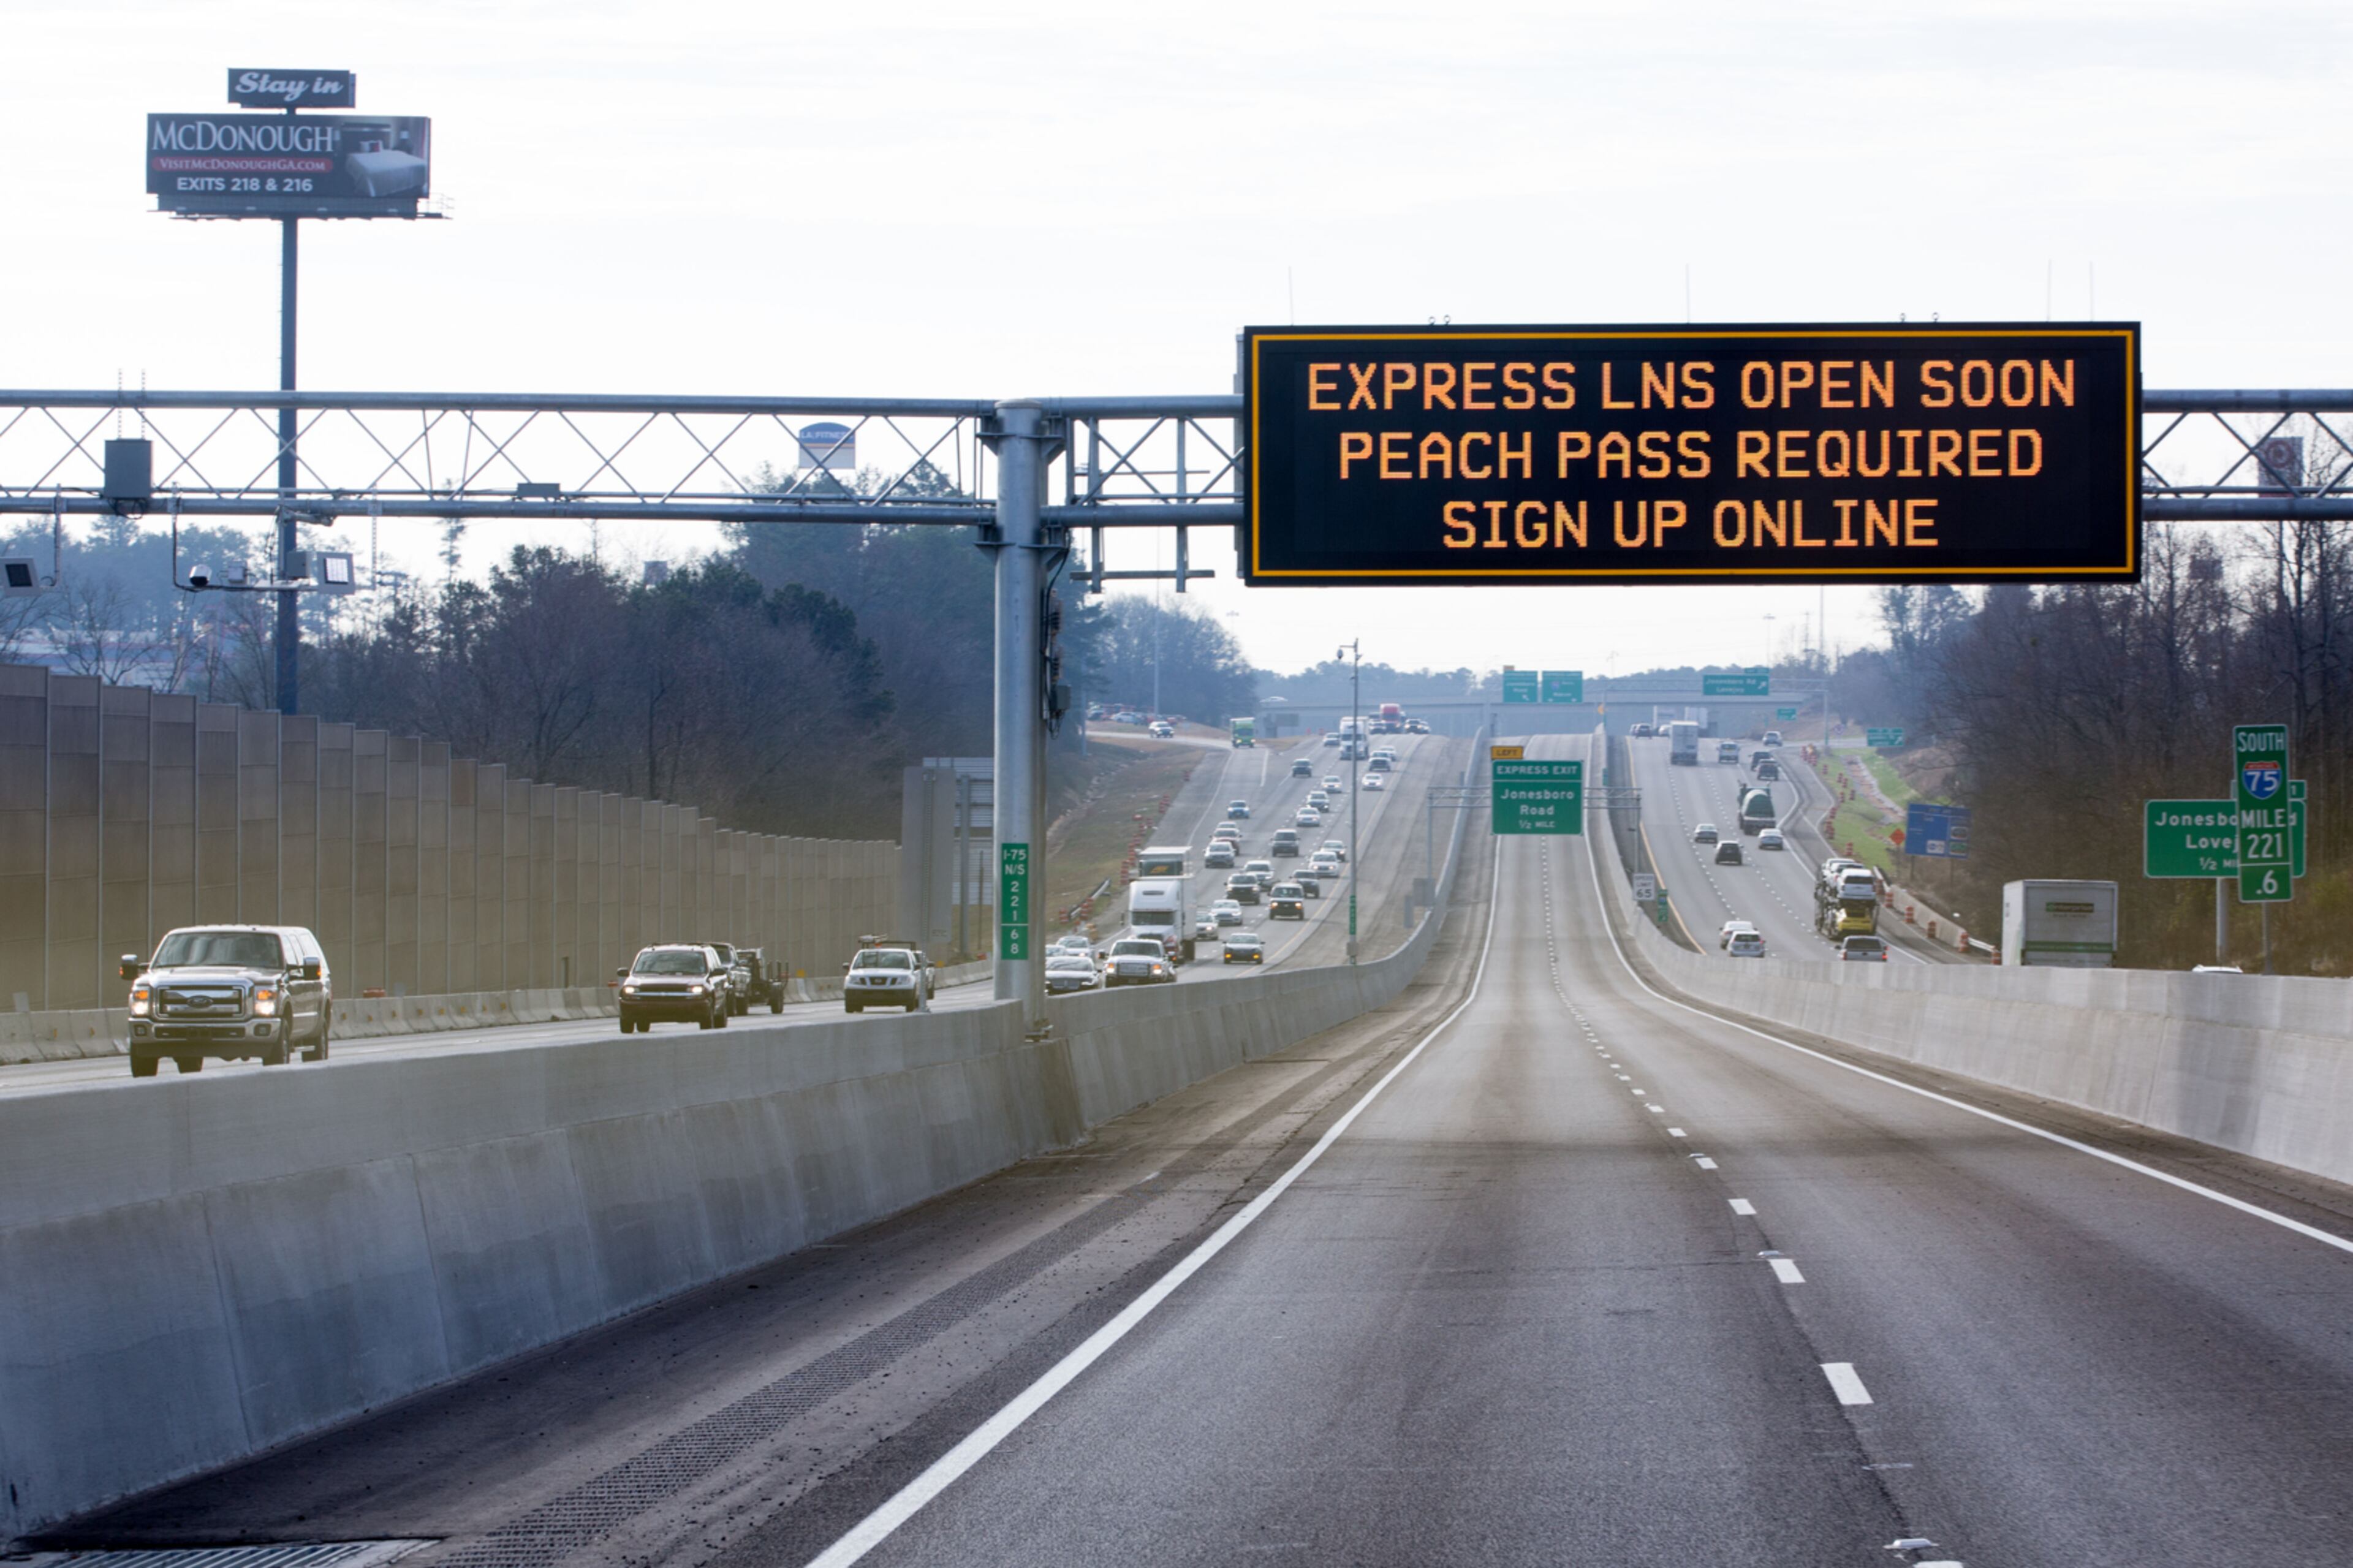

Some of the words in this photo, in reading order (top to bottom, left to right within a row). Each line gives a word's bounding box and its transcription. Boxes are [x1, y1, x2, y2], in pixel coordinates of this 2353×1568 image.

[235, 72, 308, 102] Stay
[311, 77, 344, 94] in
[176, 177, 225, 191] EXITS
[230, 178, 260, 192] 218
[265, 179, 278, 192] &
[282, 179, 313, 192] 216
[1308, 362, 1576, 411] EXPRESS
[1601, 362, 1716, 410] LNS
[1740, 360, 1895, 409] OPEN
[1920, 359, 2075, 408] SOON
[1339, 431, 1533, 480] PEACH
[1557, 431, 1711, 479] PASS
[1736, 429, 2044, 478] REQUIRED
[1442, 501, 1588, 548] SIGN
[1613, 501, 1688, 548] UP
[1713, 499, 1939, 548] ONLINE
[2237, 732, 2285, 752] SOUTH
[1496, 765, 1549, 775] EXPRESS
[1553, 765, 1578, 775] EXIT
[2246, 770, 2278, 792] 75
[1500, 789, 1574, 800] Jonesboro
[1520, 805, 1555, 815] Road
[2240, 809, 2286, 828] MILE
[2246, 833, 2283, 858] 221
[1005, 864, 1025, 875] N/S
[2256, 869, 2278, 895] .6
[1637, 888, 1652, 898] 65
